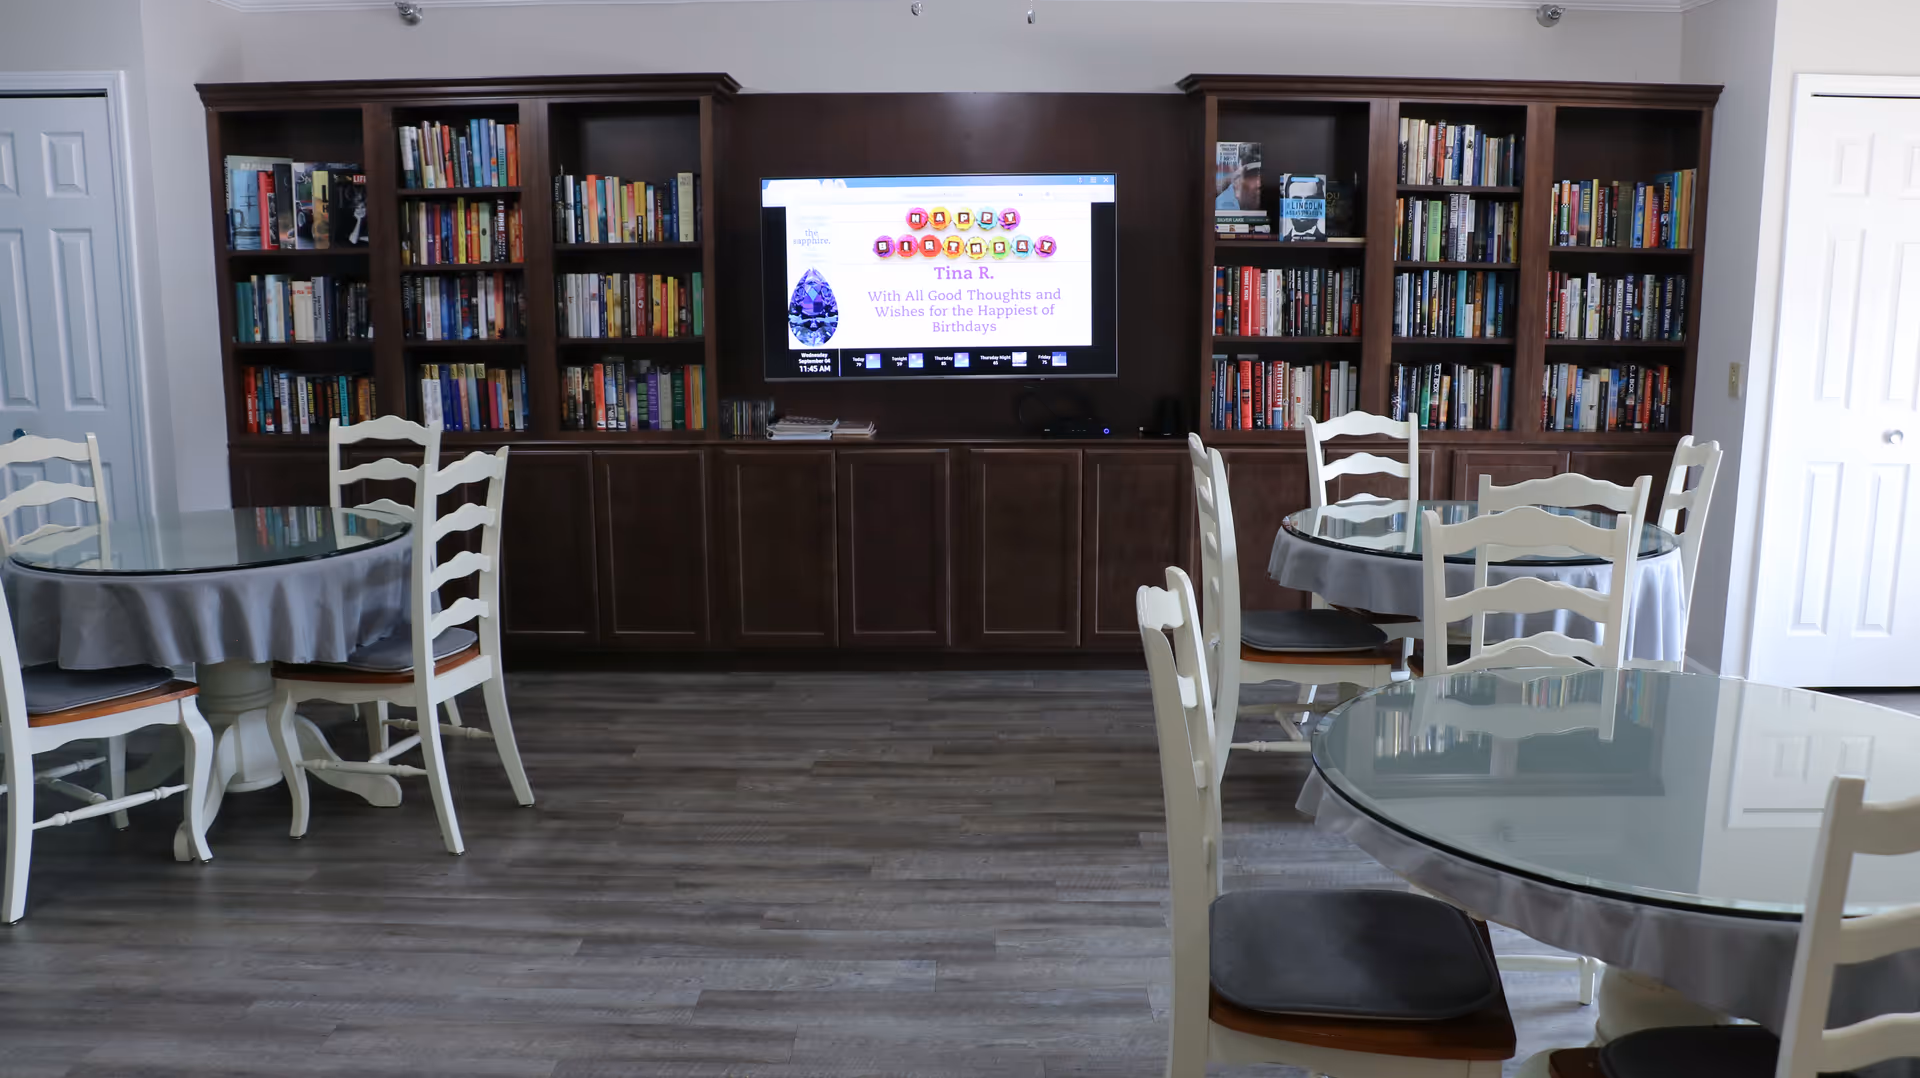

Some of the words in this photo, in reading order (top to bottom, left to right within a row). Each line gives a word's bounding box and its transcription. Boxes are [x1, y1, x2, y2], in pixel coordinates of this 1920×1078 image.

[1291, 201, 1322, 210] LINCOLN
[910, 211, 1017, 225] HAPPY
[804, 228, 819, 238] the
[876, 239, 1053, 256] BIRTHDAY
[934, 266, 973, 280] Tina
[978, 266, 994, 280] R.
[868, 290, 900, 302] With
[905, 290, 923, 301] All
[928, 289, 962, 301] Good
[967, 288, 1031, 303] Thoughts
[1036, 288, 1061, 300] and
[875, 306, 925, 317] Wishes
[929, 305, 948, 316] for
[952, 305, 973, 316] the
[978, 304, 1038, 319] Happiest
[1042, 304, 1055, 316] of
[932, 320, 997, 335] Birthdays
